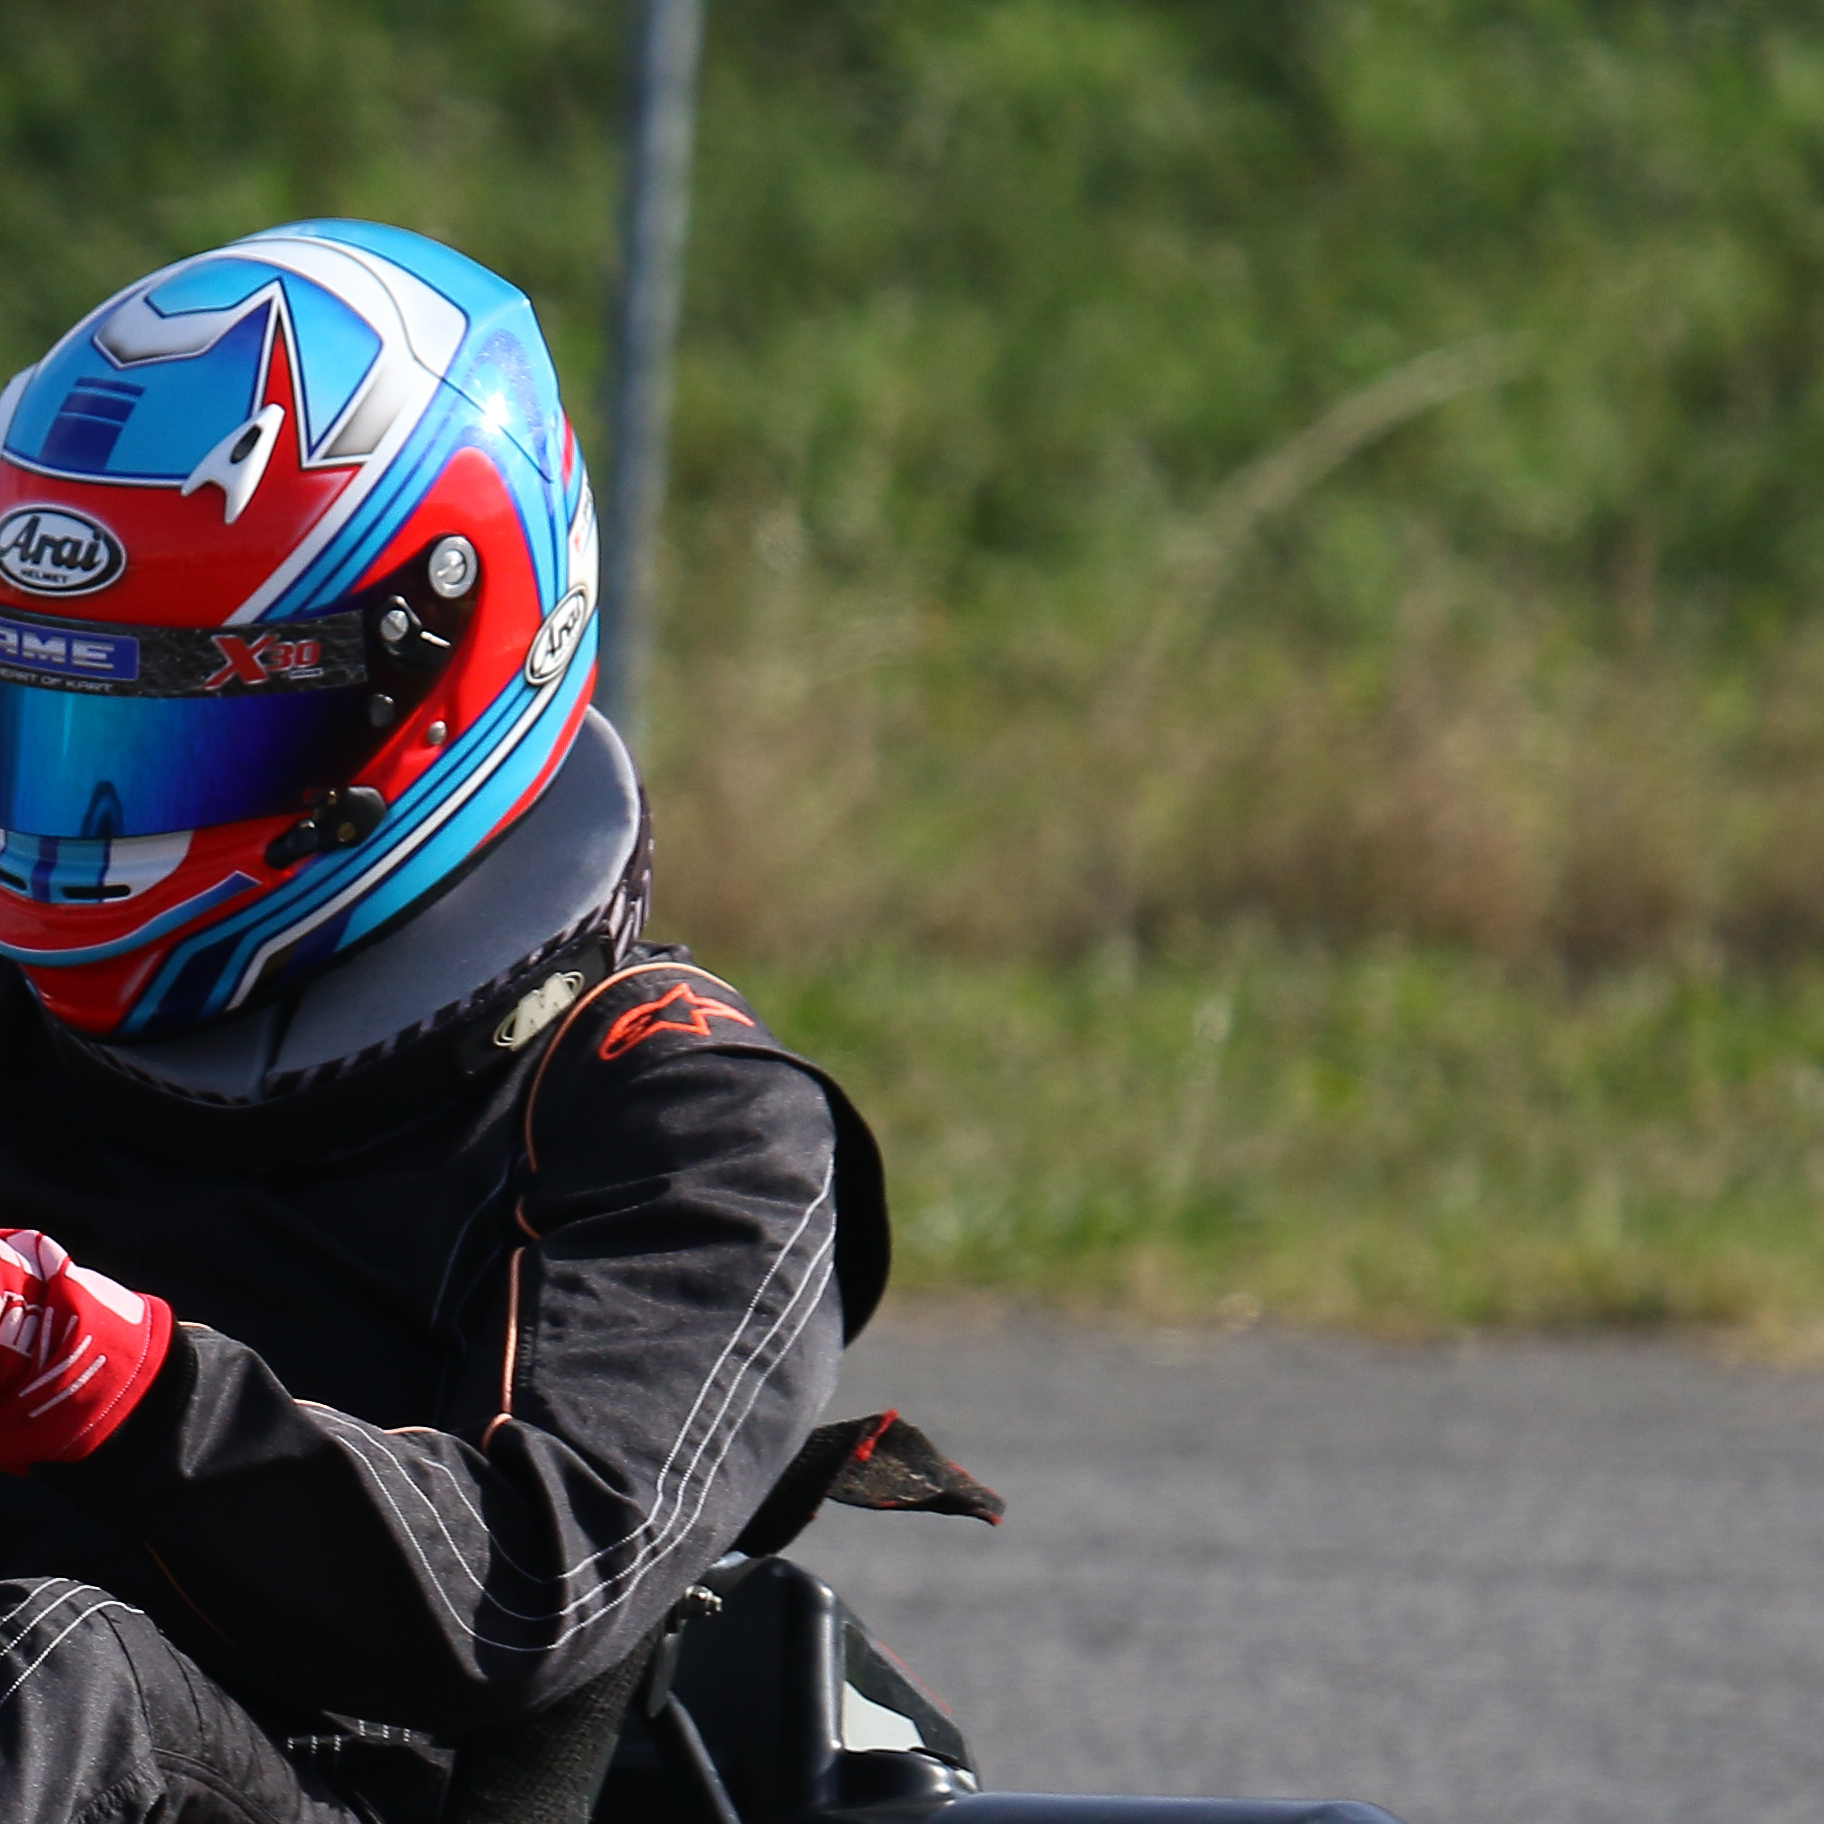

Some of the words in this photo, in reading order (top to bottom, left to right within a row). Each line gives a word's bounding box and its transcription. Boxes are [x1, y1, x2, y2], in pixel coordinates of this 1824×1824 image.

[2, 514, 105, 572] Arai
[20, 567, 70, 585] HELMET
[203, 632, 323, 691] X30
[41, 674, 62, 686] OF
[65, 678, 114, 693] KART
